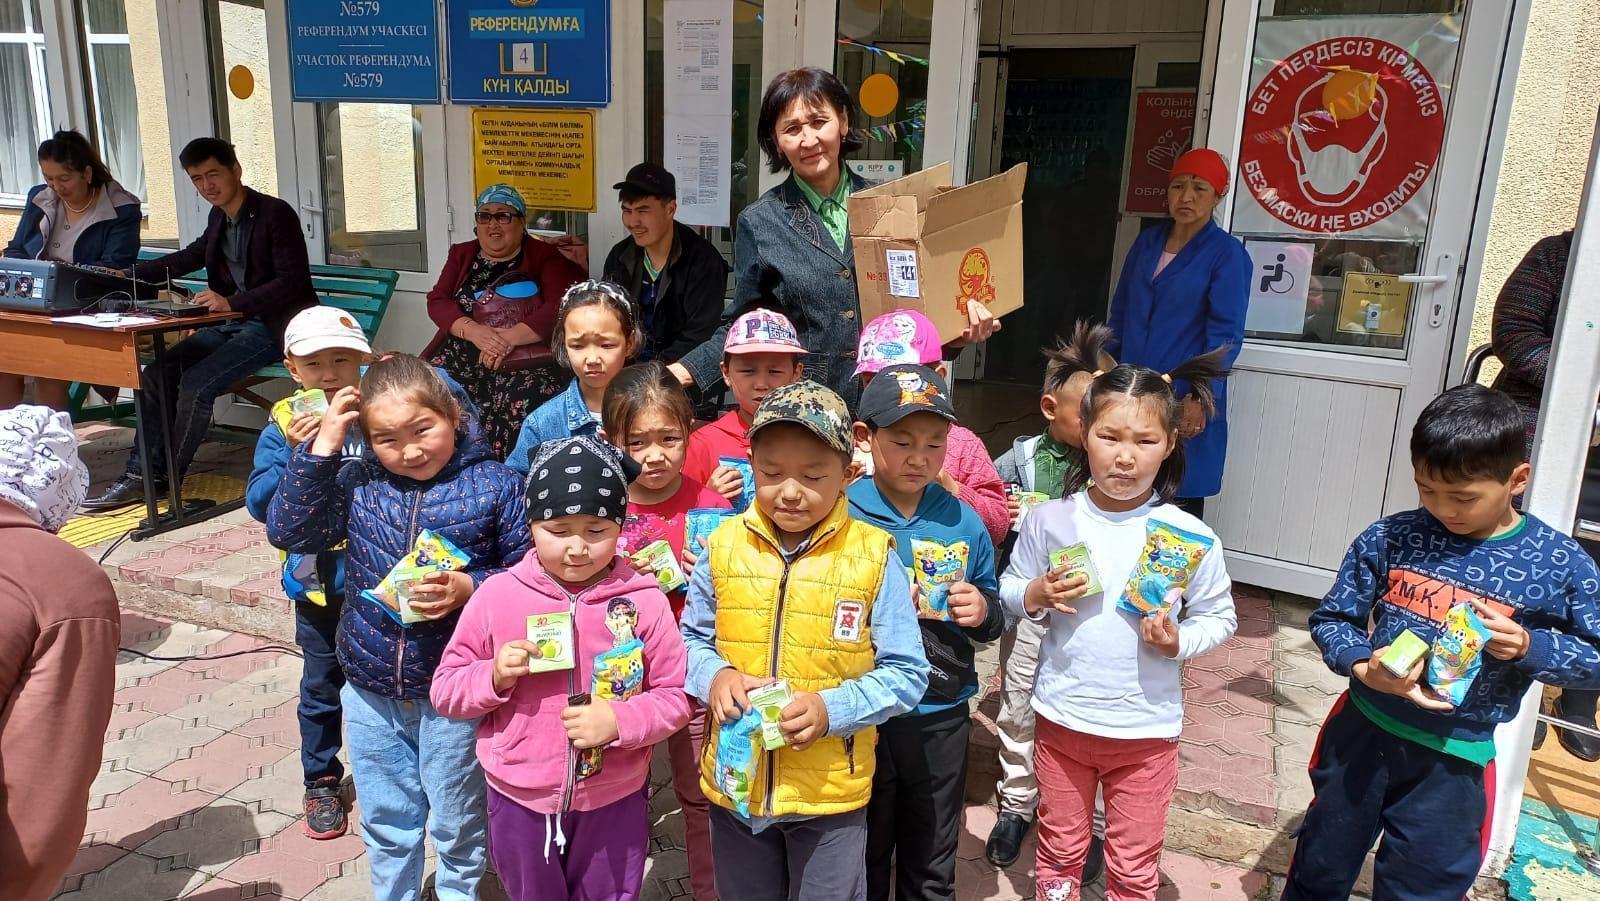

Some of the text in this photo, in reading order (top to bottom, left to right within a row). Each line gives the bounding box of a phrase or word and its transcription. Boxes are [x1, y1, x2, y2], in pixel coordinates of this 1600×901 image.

[339, 0, 380, 17] №579
[298, 24, 427, 38] РЕФЕРЕНДУМ УЧАСКЕСІ
[470, 16, 580, 34] РЕФЕРЕНДУМҒА
[296, 54, 432, 69] УЧАСТОК РЕФЕРЕНДУМА
[520, 48, 528, 64] 4
[343, 72, 384, 88] №579
[483, 78, 570, 96] КҮН ҚАЛДЫ
[1252, 40, 1438, 117] БЕТ ПЕРДЕСІЗ КІРМЕҢІЗ
[1244, 159, 1430, 230] БЕЗ МАСКИ НЕ ВХОДИТЬ!
